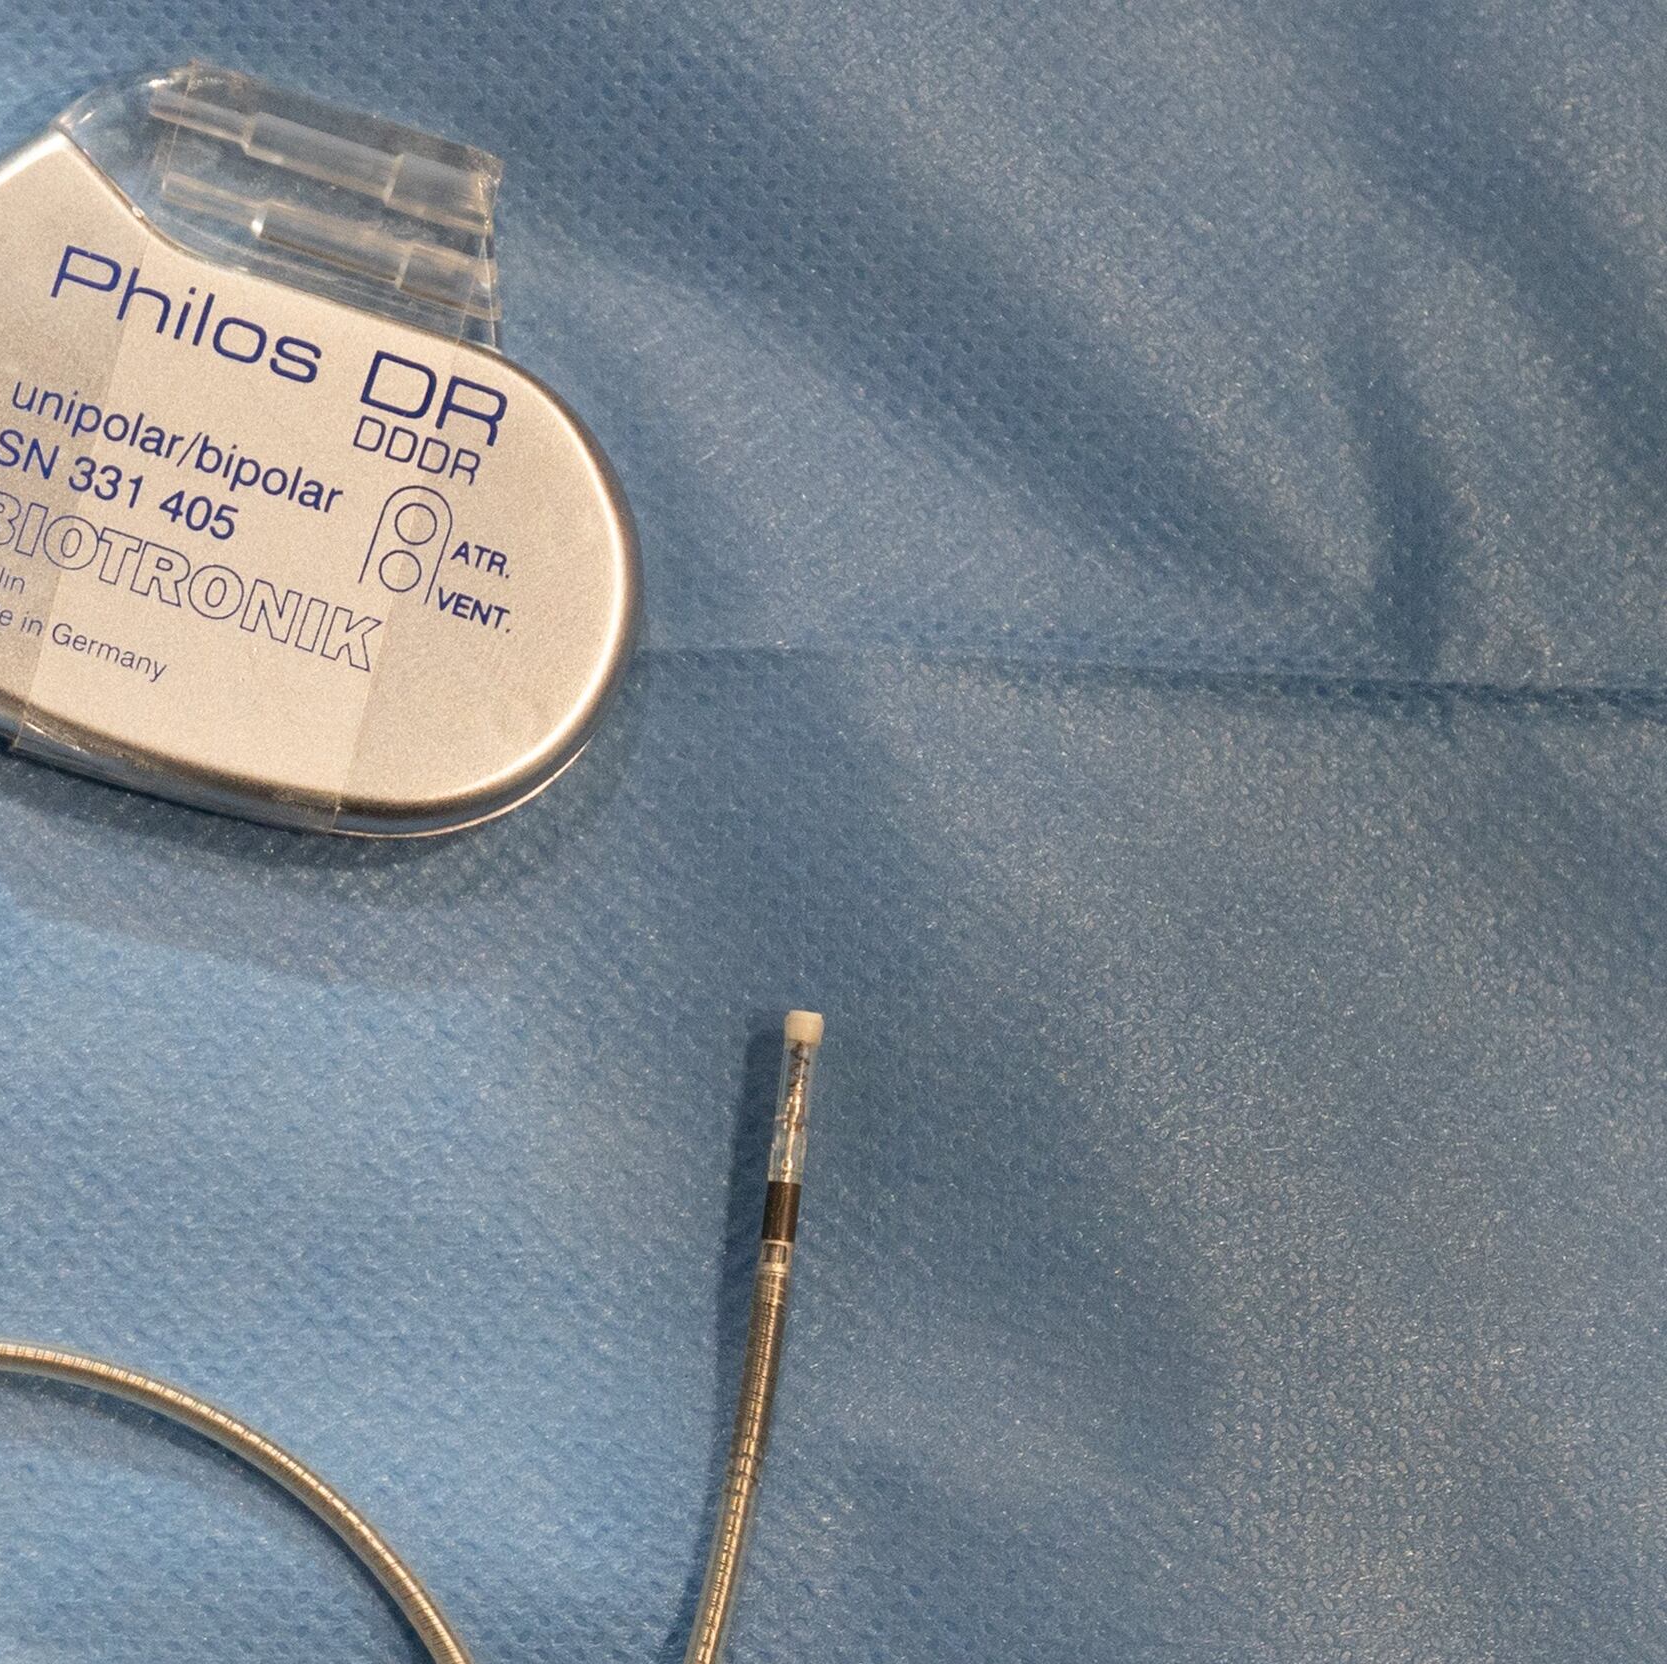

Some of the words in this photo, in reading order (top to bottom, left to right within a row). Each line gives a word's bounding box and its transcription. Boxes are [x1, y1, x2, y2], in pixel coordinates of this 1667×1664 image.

[50, 245, 322, 383] Philos
[360, 351, 508, 446] DR
[11, 381, 344, 515] unipolar/bipolar
[353, 416, 481, 485] DDDR
[69, 458, 143, 507] 331
[159, 495, 236, 541] 405
[450, 542, 511, 579] ATR.
[21, 609, 42, 634] in
[52, 622, 167, 683] Germany
[438, 588, 511, 634] VENT.
